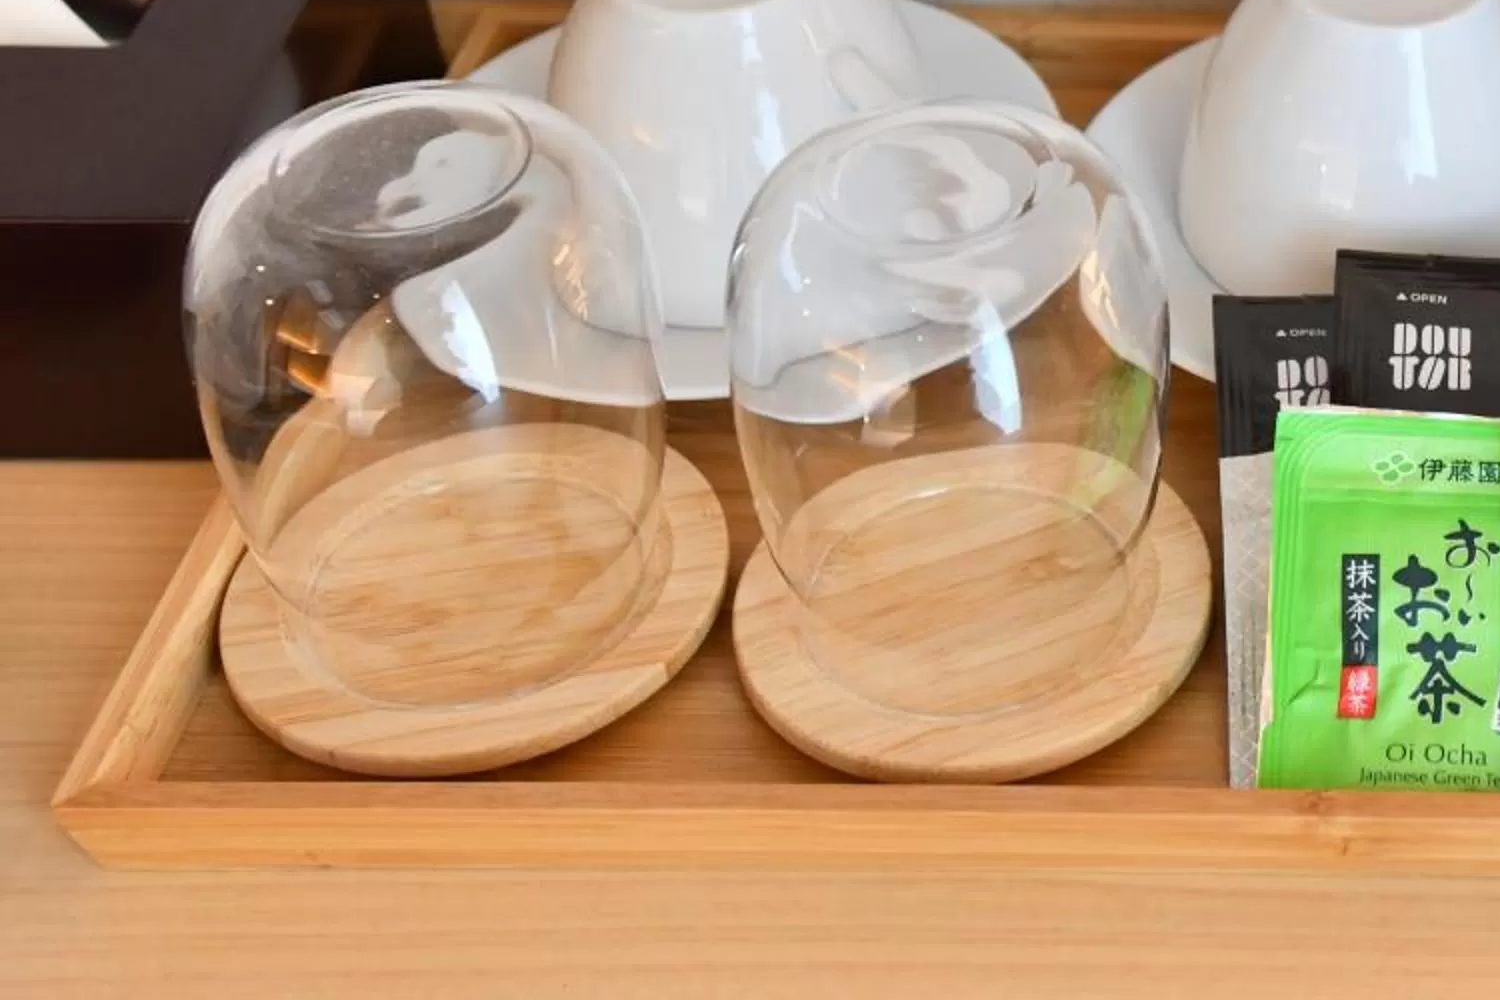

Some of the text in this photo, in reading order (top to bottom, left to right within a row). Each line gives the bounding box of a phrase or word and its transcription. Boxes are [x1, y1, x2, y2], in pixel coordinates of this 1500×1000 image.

[1410, 292, 1448, 305] OPEN
[1289, 328, 1328, 338] OPEN
[1346, 559, 1377, 660] 抹茶入り
[1385, 742, 1488, 767] Oi Ocha
[1359, 767, 1428, 786] Japanese
[1438, 769, 1481, 787] Green
